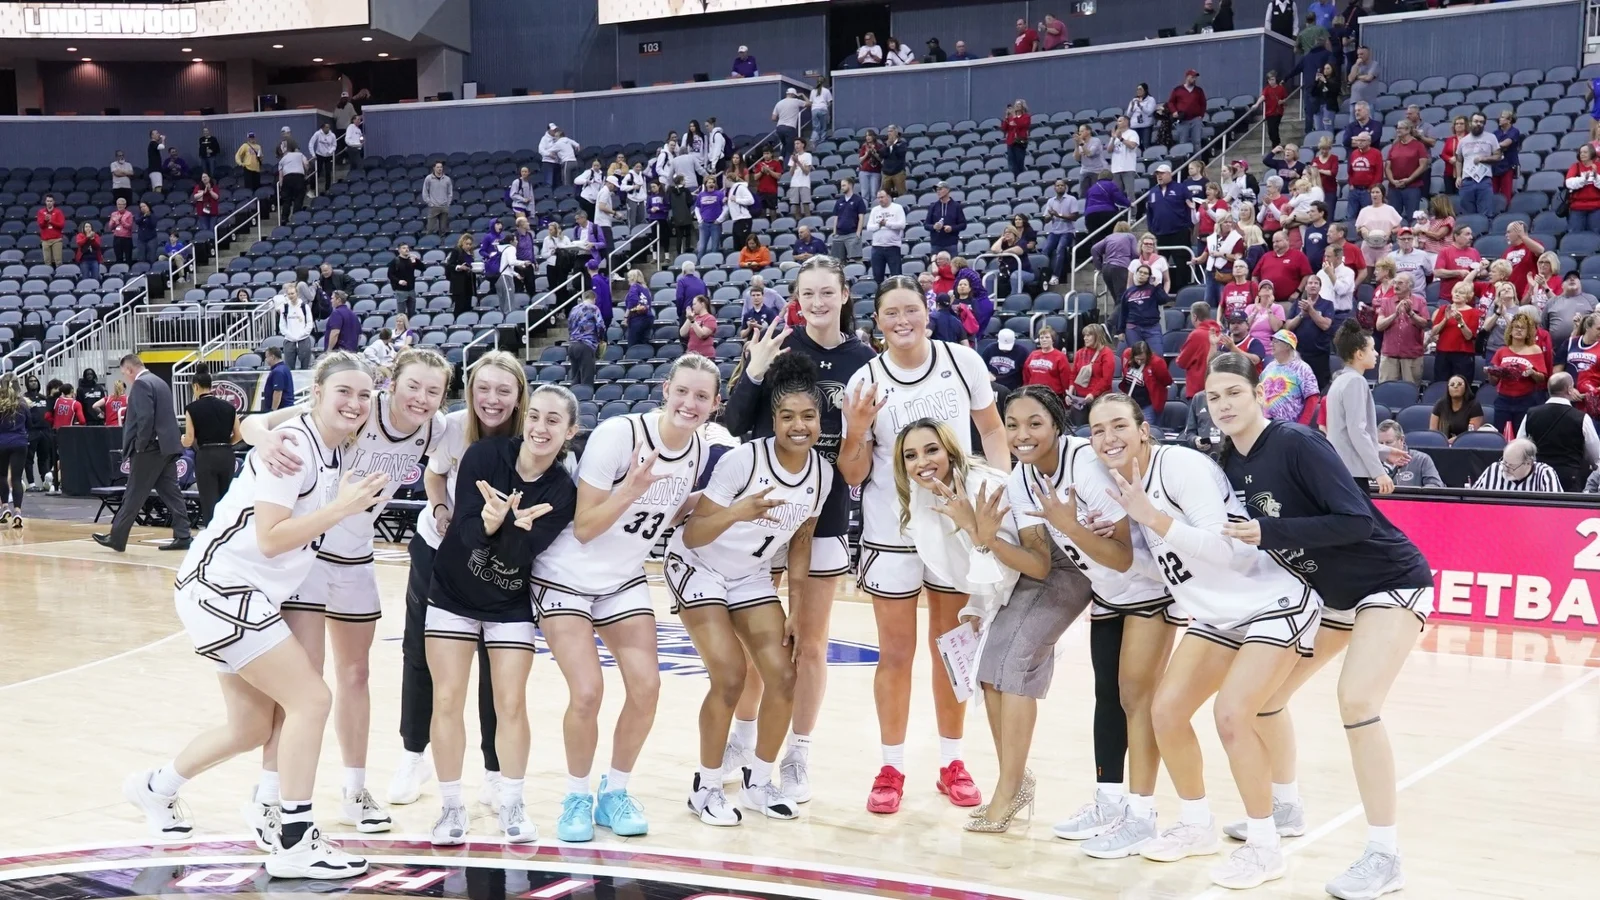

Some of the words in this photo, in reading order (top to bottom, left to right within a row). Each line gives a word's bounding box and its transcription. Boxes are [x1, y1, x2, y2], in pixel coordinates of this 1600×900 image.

[23, 8, 198, 34] LINDENWOOD
[1075, 2, 1094, 13] 104
[642, 43, 659, 53] 103
[887, 387, 961, 436] LIONS
[352, 449, 418, 483] LIONS
[624, 511, 665, 540] 33
[752, 535, 775, 558] 1
[1157, 551, 1194, 586] 22
[1431, 569, 1600, 625] ETBA
